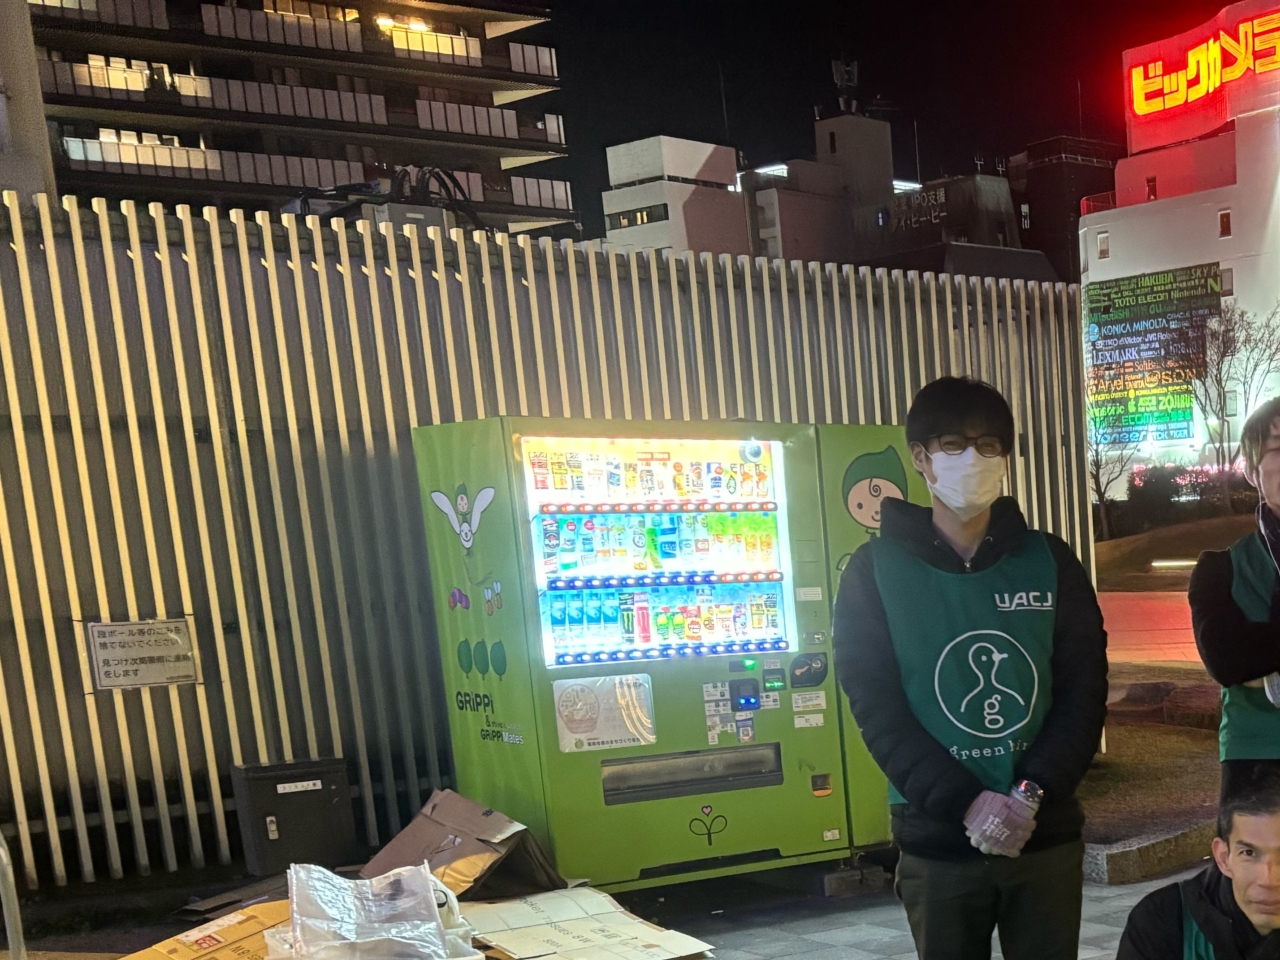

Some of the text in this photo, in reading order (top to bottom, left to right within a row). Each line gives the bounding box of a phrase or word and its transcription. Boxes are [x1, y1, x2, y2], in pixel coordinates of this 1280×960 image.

[1138, 272, 1174, 287] HAKUBA
[1190, 267, 1208, 279] SKY
[1114, 296, 1136, 307] TOTO
[1138, 292, 1168, 304] ELECOM
[1171, 286, 1206, 299] Nintendo
[1090, 308, 1130, 323] MITSUBISHI
[1149, 303, 1162, 314] au
[1101, 322, 1130, 336] KONICA
[1132, 317, 1168, 332] MINOLTA
[1145, 332, 1157, 342] JVC
[1092, 346, 1139, 364] LEXMARK
[994, 591, 1053, 611] UACJ
[103, 668, 140, 679] をします
[949, 745, 1006, 761] green
